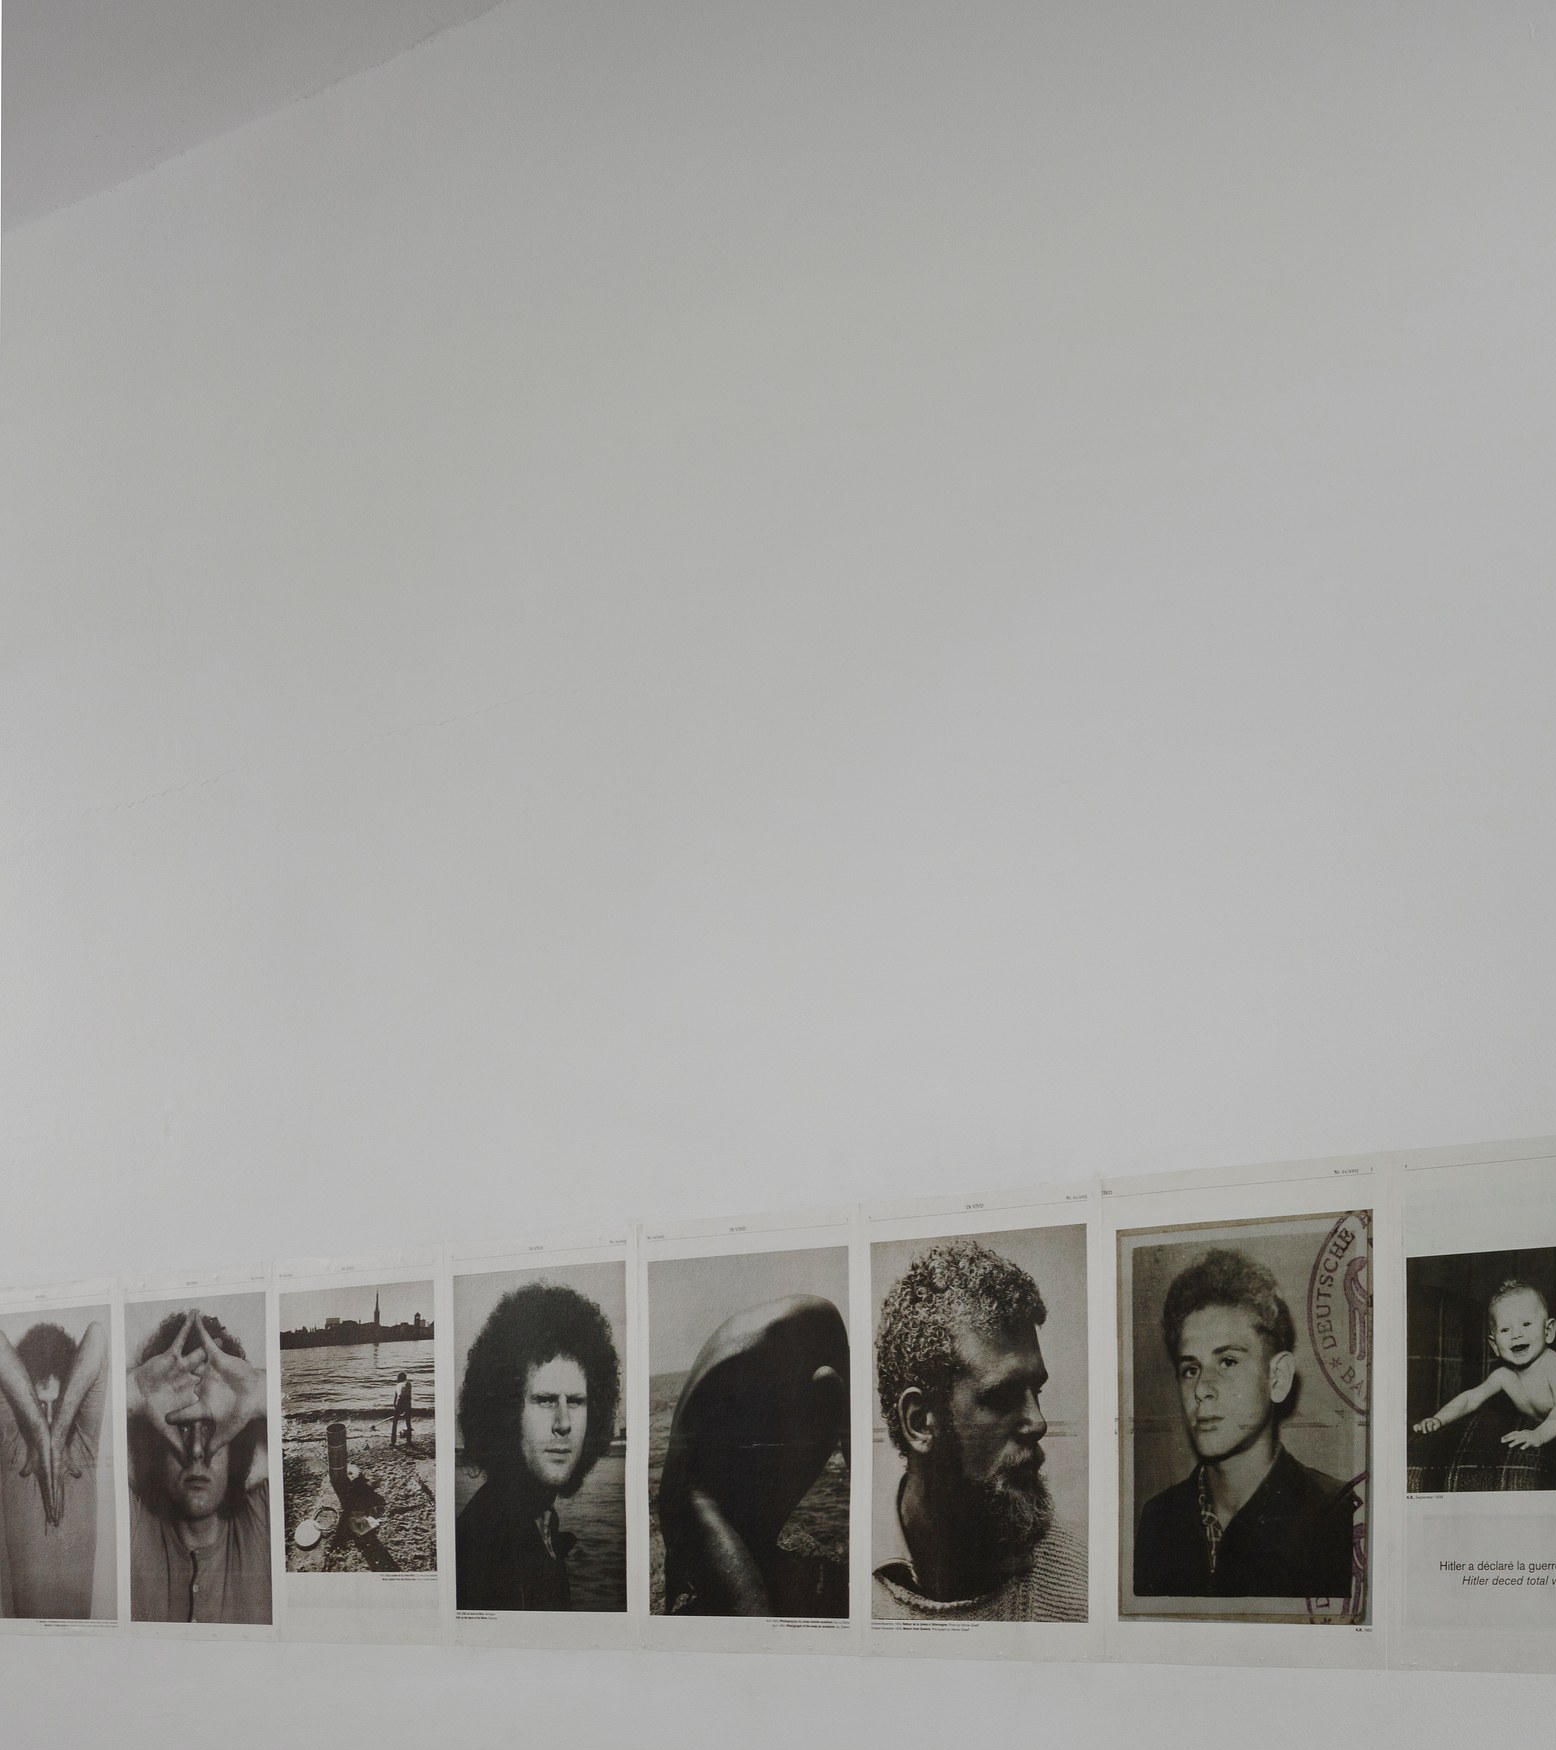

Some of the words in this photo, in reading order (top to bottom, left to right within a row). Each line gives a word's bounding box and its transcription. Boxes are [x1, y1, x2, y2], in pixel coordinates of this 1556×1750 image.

[1316, 1228, 1354, 1350] DEUTSCHE
[1440, 1561, 1466, 1570] Hitler
[1477, 1561, 1514, 1570] déclaré
[1517, 1561, 1526, 1570] la
[1462, 1576, 1489, 1585] Hitler
[1492, 1576, 1524, 1585] deced
[1527, 1576, 1549, 1585] total
